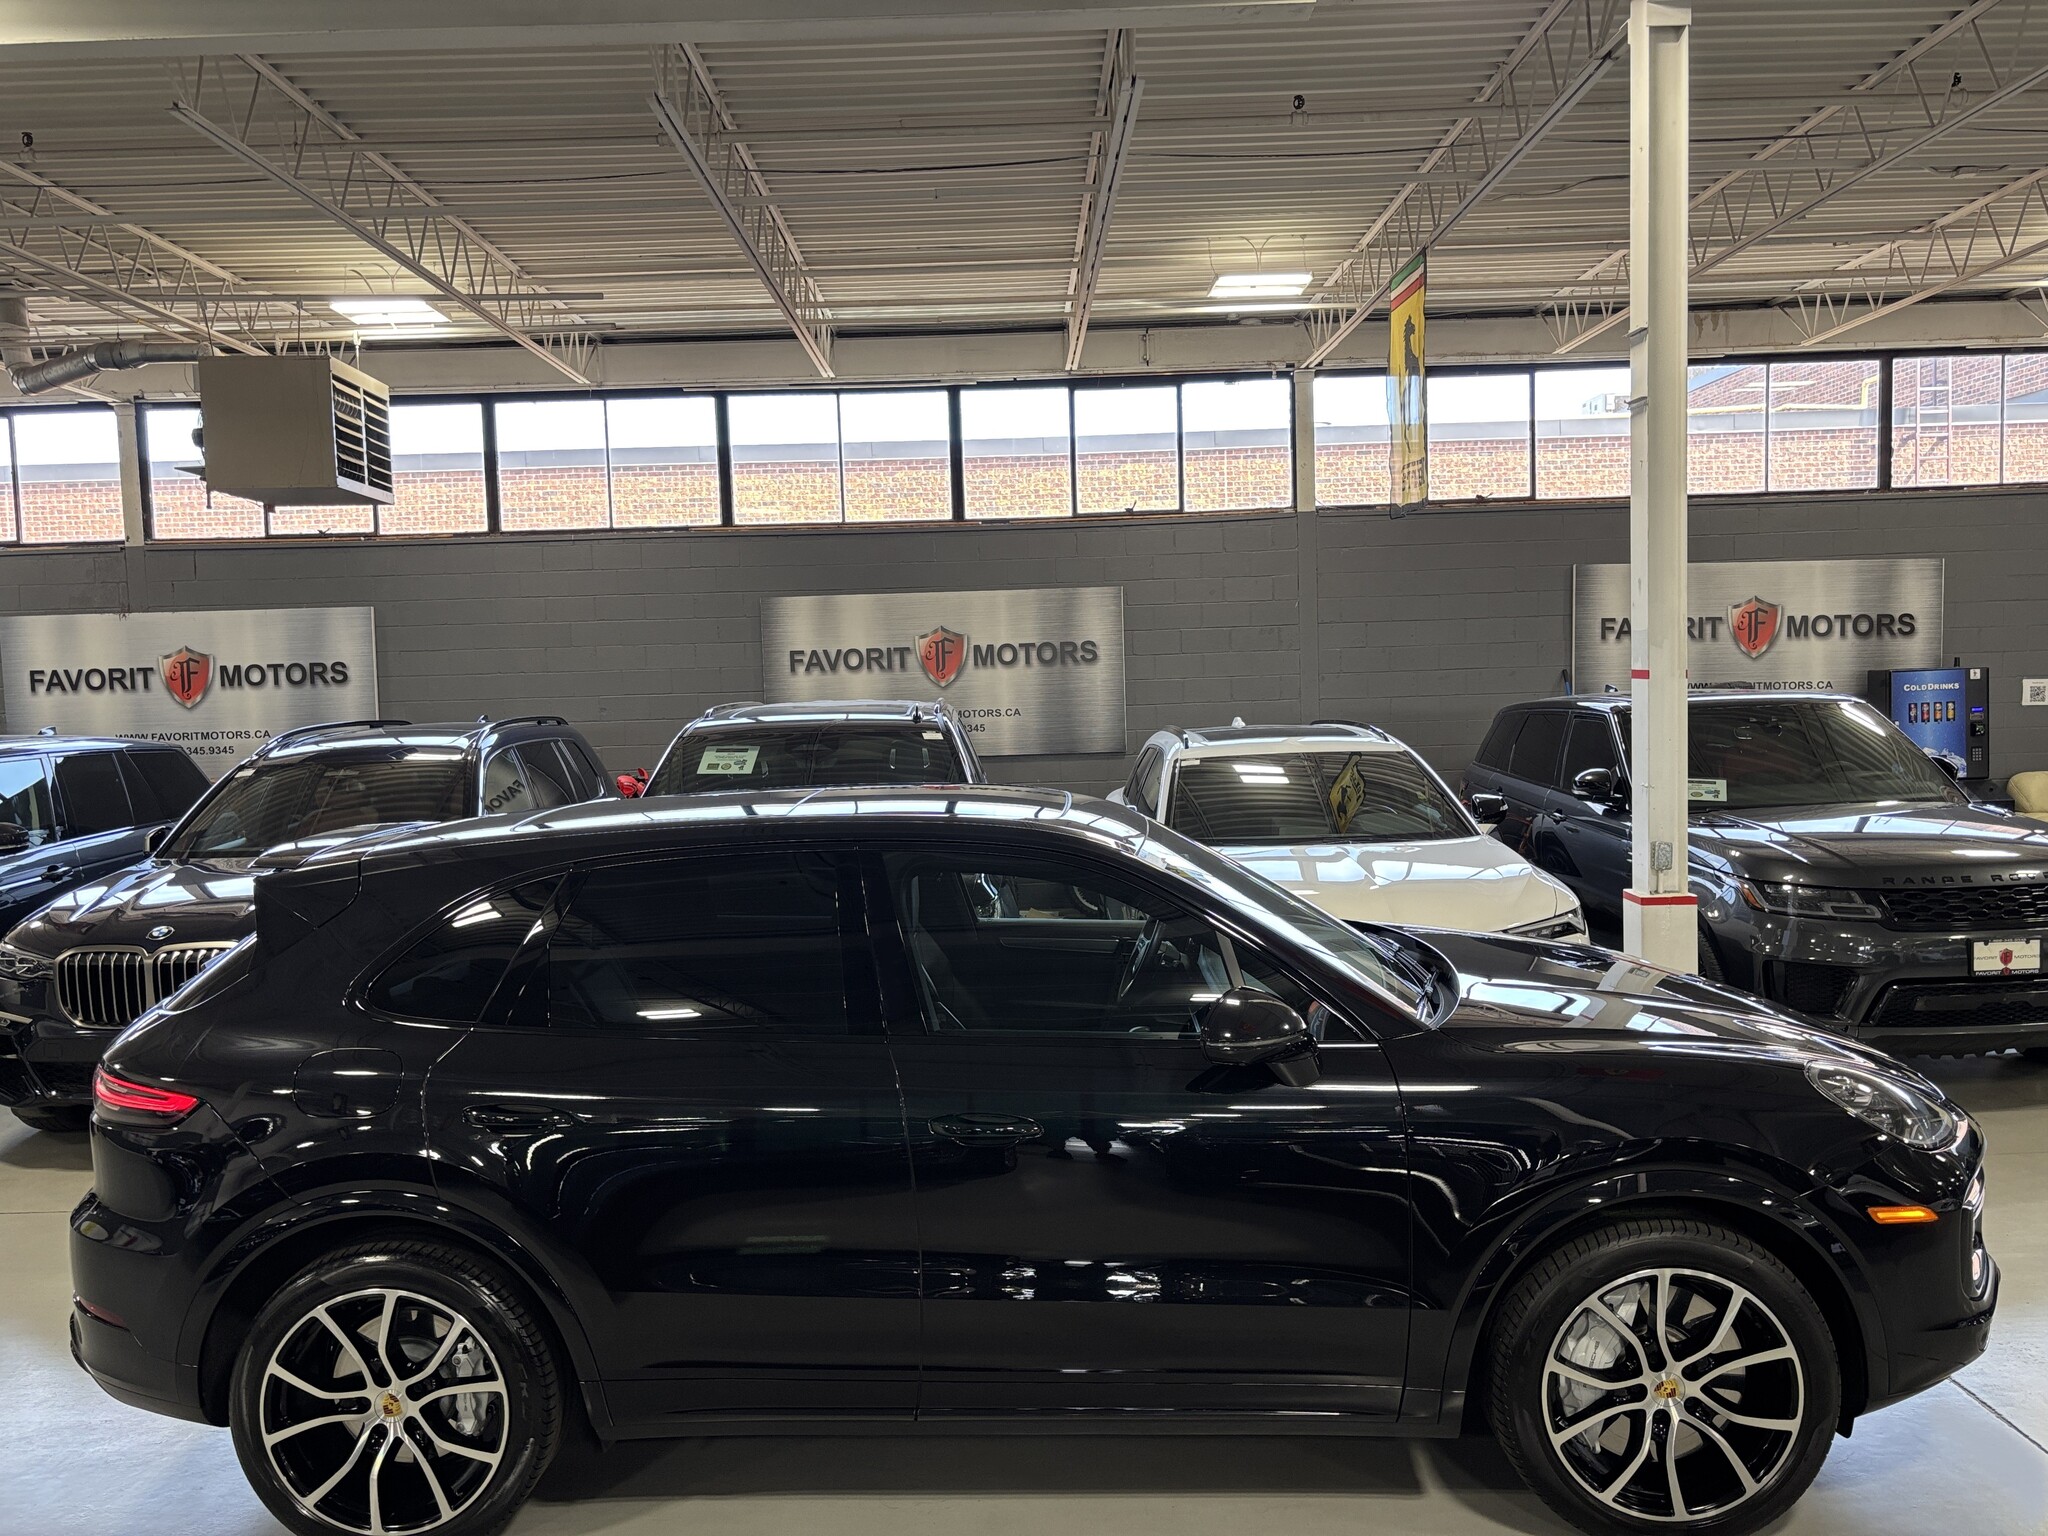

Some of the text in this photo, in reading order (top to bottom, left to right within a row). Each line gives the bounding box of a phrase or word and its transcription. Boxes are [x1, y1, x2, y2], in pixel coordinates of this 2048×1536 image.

[1601, 613, 1916, 640] FAIT MOTORS
[789, 640, 1098, 673] FAVORIT MOTORS
[29, 661, 349, 693] FAVORIT MOTORS
[115, 730, 271, 742] WWFAVORITMOTORS.CA
[963, 724, 986, 732] 345
[1882, 875, 1974, 885] RANGE
